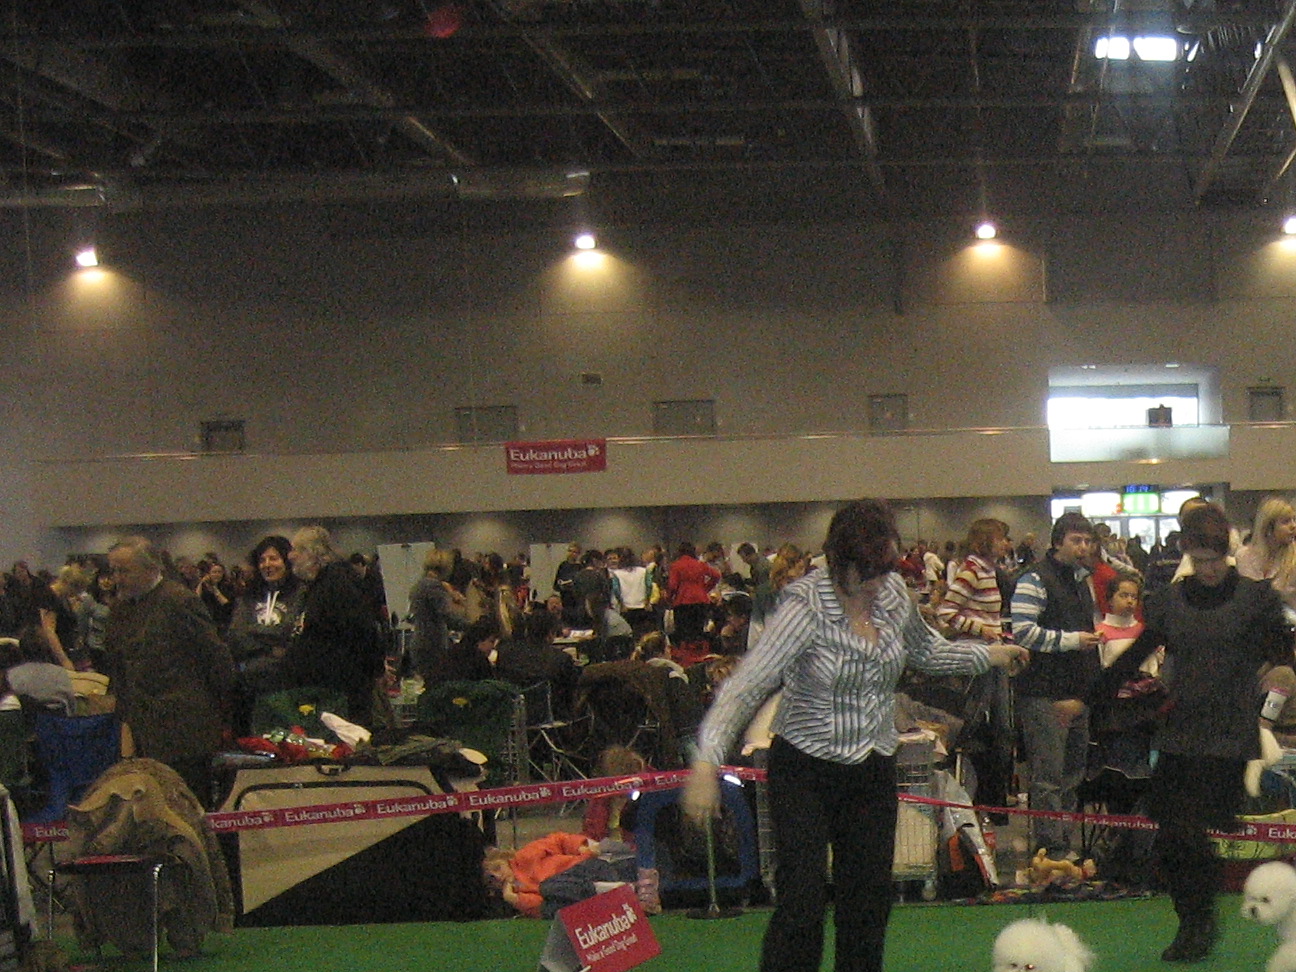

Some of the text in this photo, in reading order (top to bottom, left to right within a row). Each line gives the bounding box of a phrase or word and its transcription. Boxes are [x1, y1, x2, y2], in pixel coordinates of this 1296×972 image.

[510, 447, 587, 461] Eukanuba
[211, 781, 632, 829] kanuba Eukanuba Eukanuba Eukanuba Eukanuba
[575, 912, 630, 950] Eukanuba
